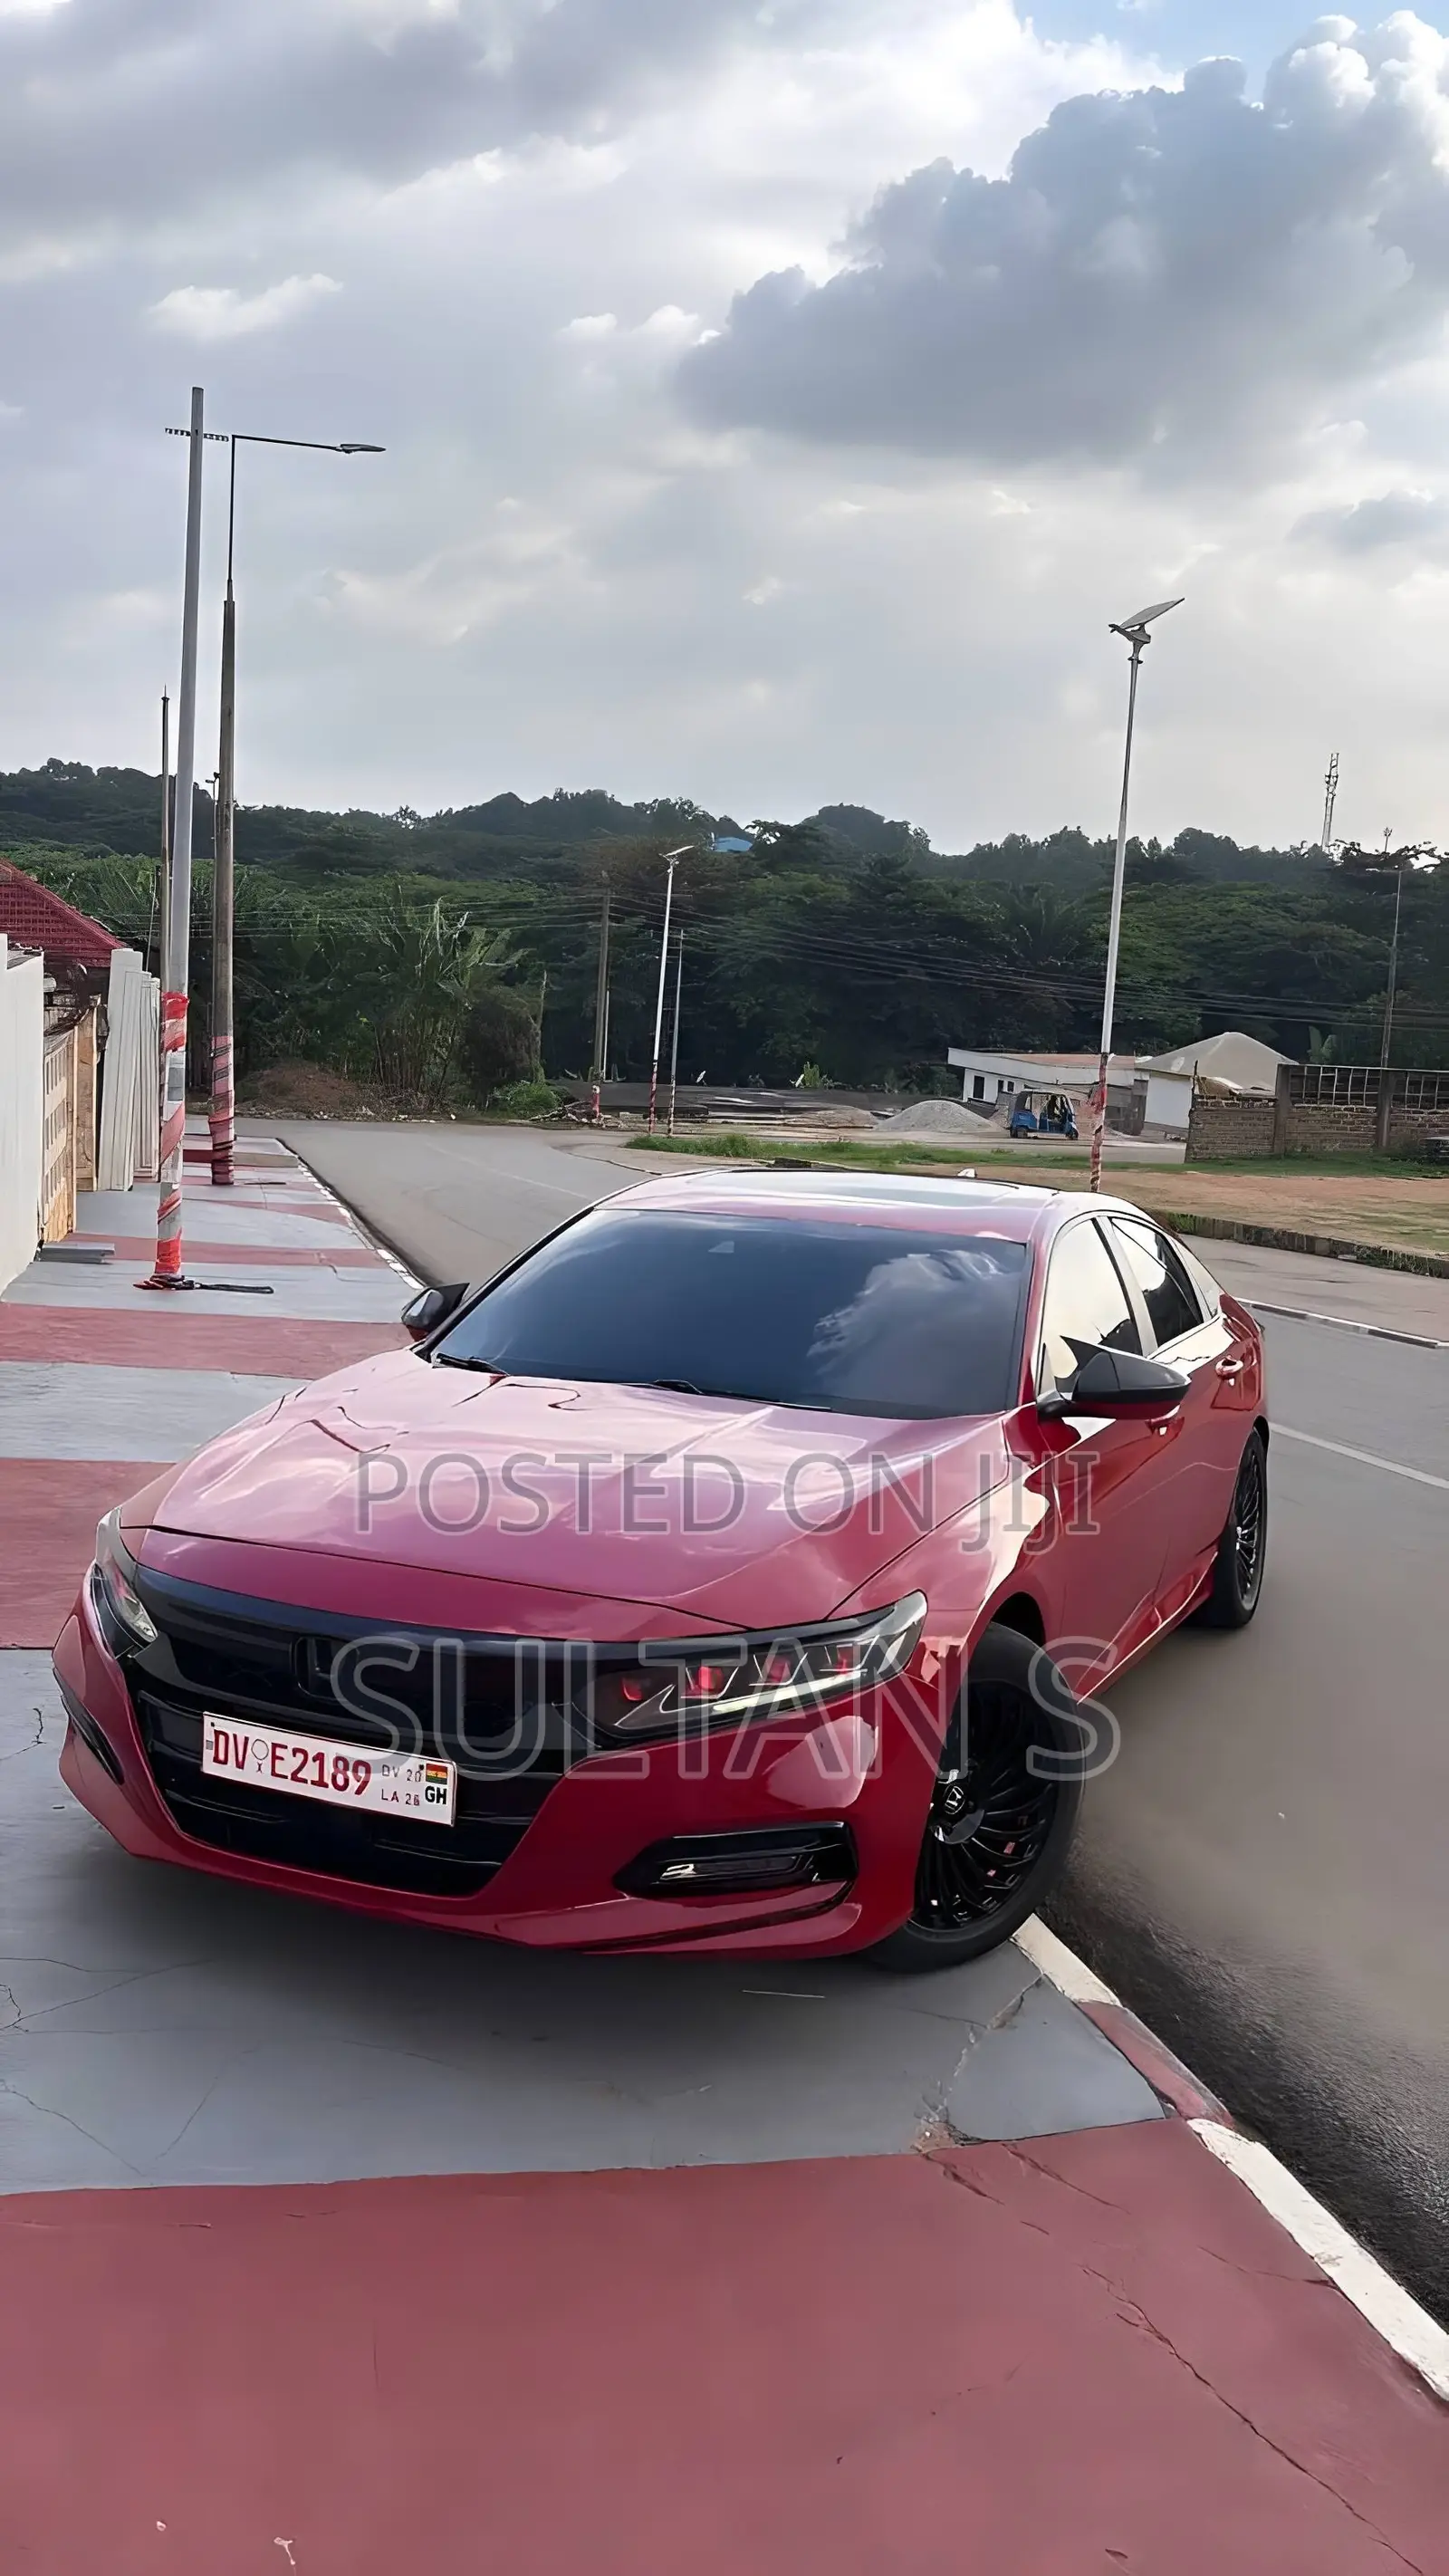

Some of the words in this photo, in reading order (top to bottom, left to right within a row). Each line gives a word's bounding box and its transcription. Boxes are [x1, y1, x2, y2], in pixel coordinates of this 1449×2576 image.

[213, 1728, 250, 1771] DV
[271, 1742, 372, 1796] E2189
[381, 1764, 399, 1777] DV
[381, 1788, 399, 1802] LA
[425, 1785, 447, 1805] GH
